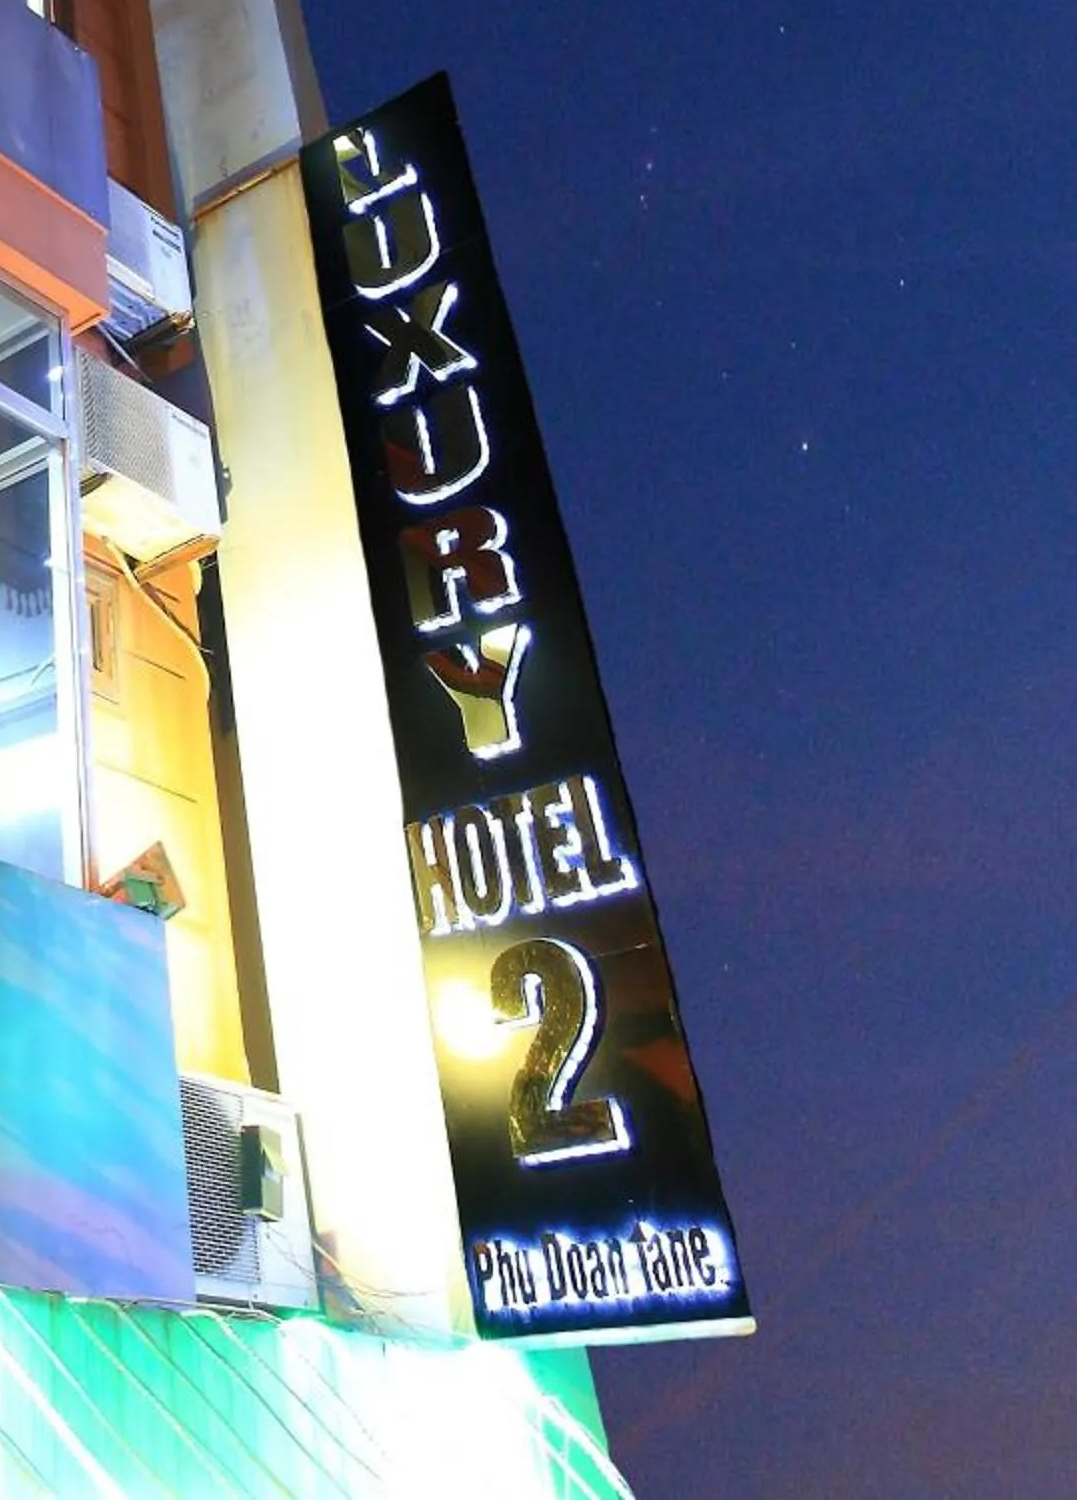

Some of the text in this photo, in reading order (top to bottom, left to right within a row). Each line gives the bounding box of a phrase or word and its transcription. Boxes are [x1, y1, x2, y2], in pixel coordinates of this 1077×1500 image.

[333, 127, 532, 759] LUXURY
[406, 774, 639, 935] HOTEL
[490, 937, 631, 1167] 2
[474, 1238, 537, 1309] Phu
[540, 1232, 630, 1301] Doan
